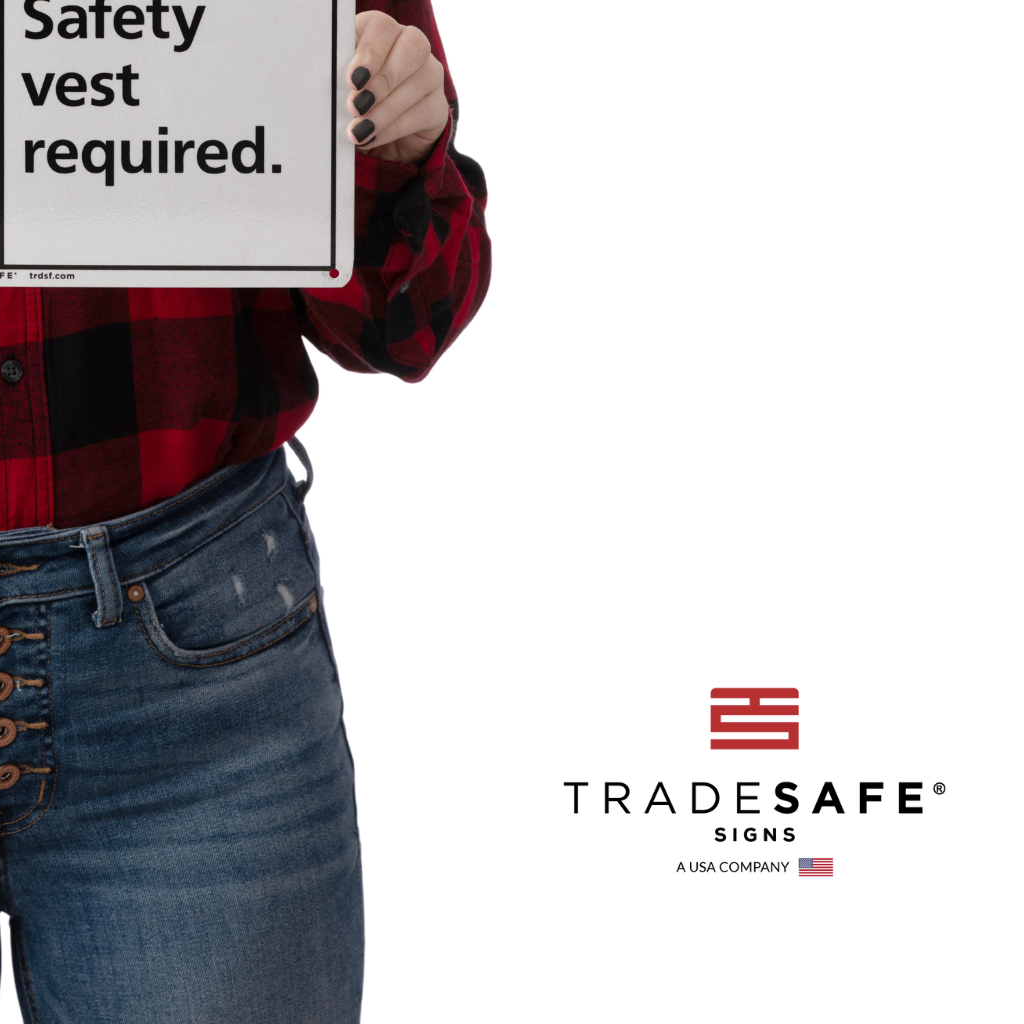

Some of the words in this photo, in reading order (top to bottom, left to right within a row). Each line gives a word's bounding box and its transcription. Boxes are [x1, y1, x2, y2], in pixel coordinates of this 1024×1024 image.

[21, 63, 140, 108] vest
[24, 125, 282, 187] required.
[29, 271, 76, 280] trdsf.com
